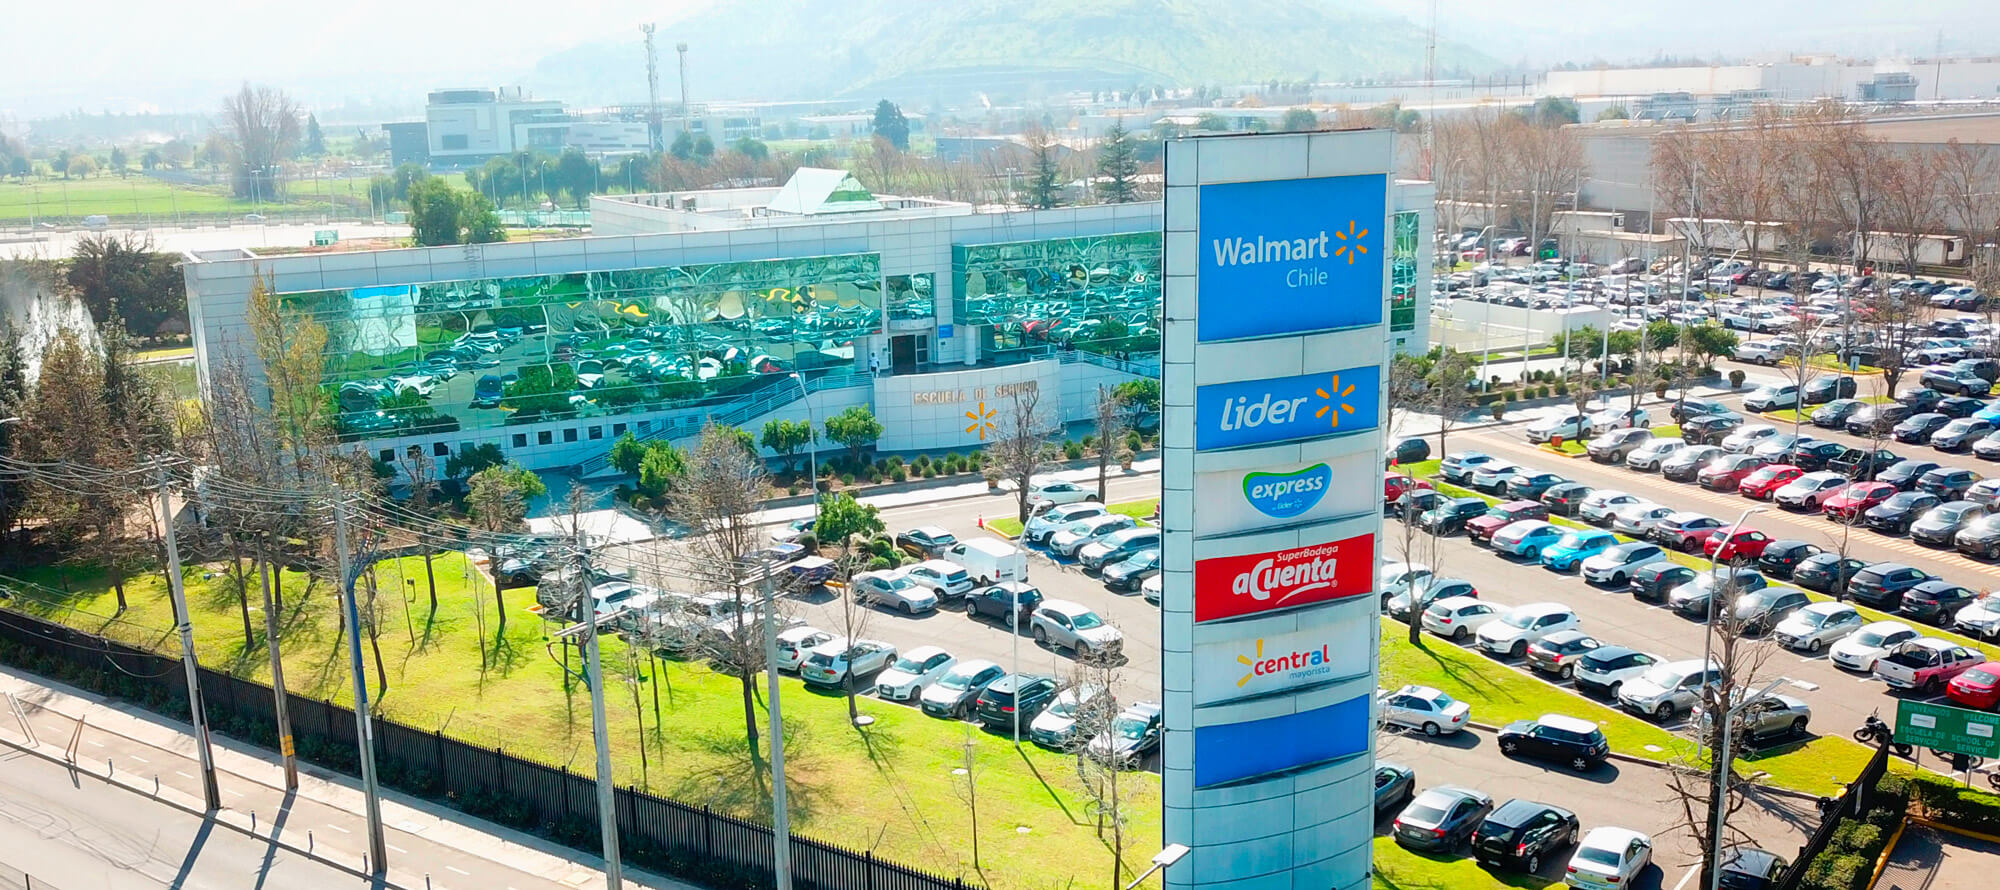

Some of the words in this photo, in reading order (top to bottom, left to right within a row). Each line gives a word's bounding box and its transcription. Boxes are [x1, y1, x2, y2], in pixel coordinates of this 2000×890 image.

[1213, 231, 1329, 267] Walmart
[1286, 267, 1328, 288] Chile
[914, 389, 966, 404] ESCUELA
[974, 387, 987, 400] DE
[1252, 474, 1323, 500] express
[1276, 545, 1338, 562] SuperBodega
[1232, 557, 1337, 600] aCuenta
[1254, 644, 1330, 676] central
[1289, 666, 1330, 679] mayorista
[1963, 713, 2000, 725] WELCOME
[1900, 725, 1933, 738] ESCUELA
[1905, 734, 1939, 747] SERVICIO
[1951, 734, 1981, 747] SCHOOL
[1985, 740, 1995, 748] OF
[1956, 743, 1988, 755] SERVICE
